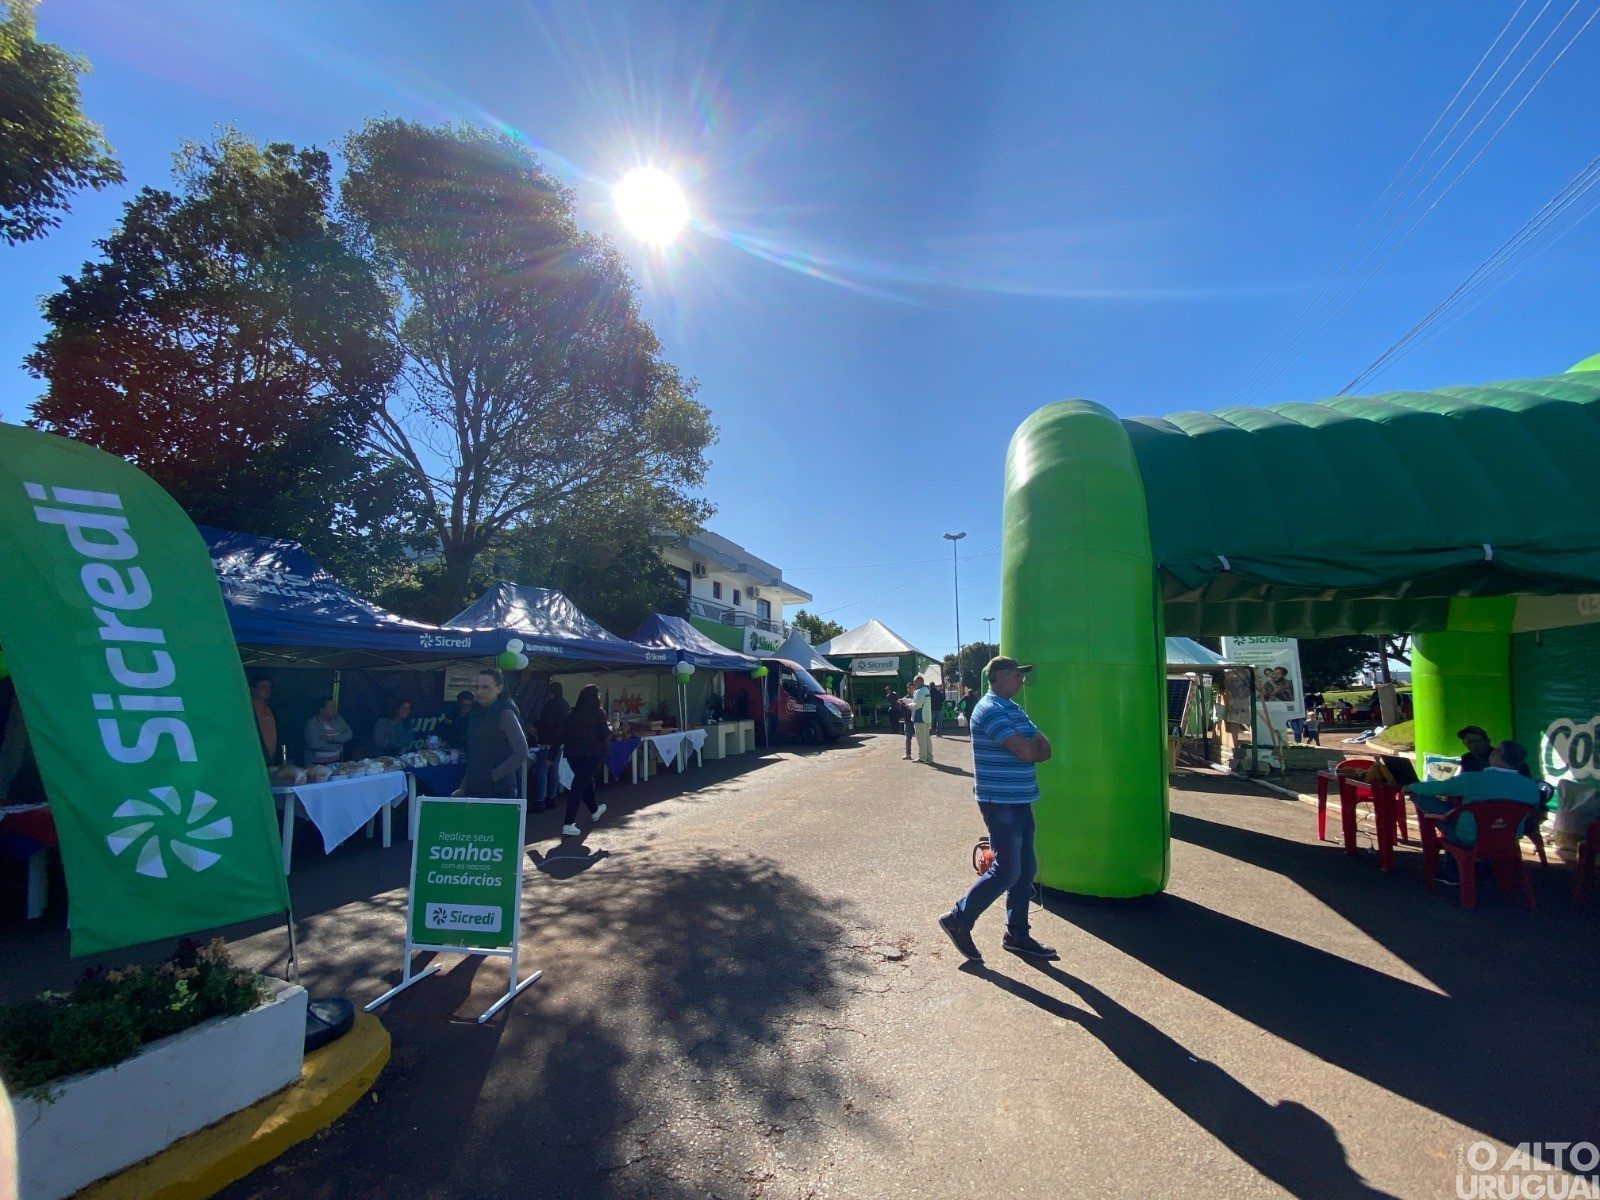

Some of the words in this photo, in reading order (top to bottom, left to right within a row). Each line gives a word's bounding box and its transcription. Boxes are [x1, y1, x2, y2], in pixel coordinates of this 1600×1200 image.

[23, 482, 198, 764] Sicredi
[434, 635, 471, 648] Sicredi
[867, 660, 894, 668] Sicredi
[438, 831, 471, 841] Realize
[473, 834, 495, 842] seus
[429, 843, 504, 862] sonhos
[427, 871, 502, 887] Consórcios
[450, 910, 495, 926] Sicredi
